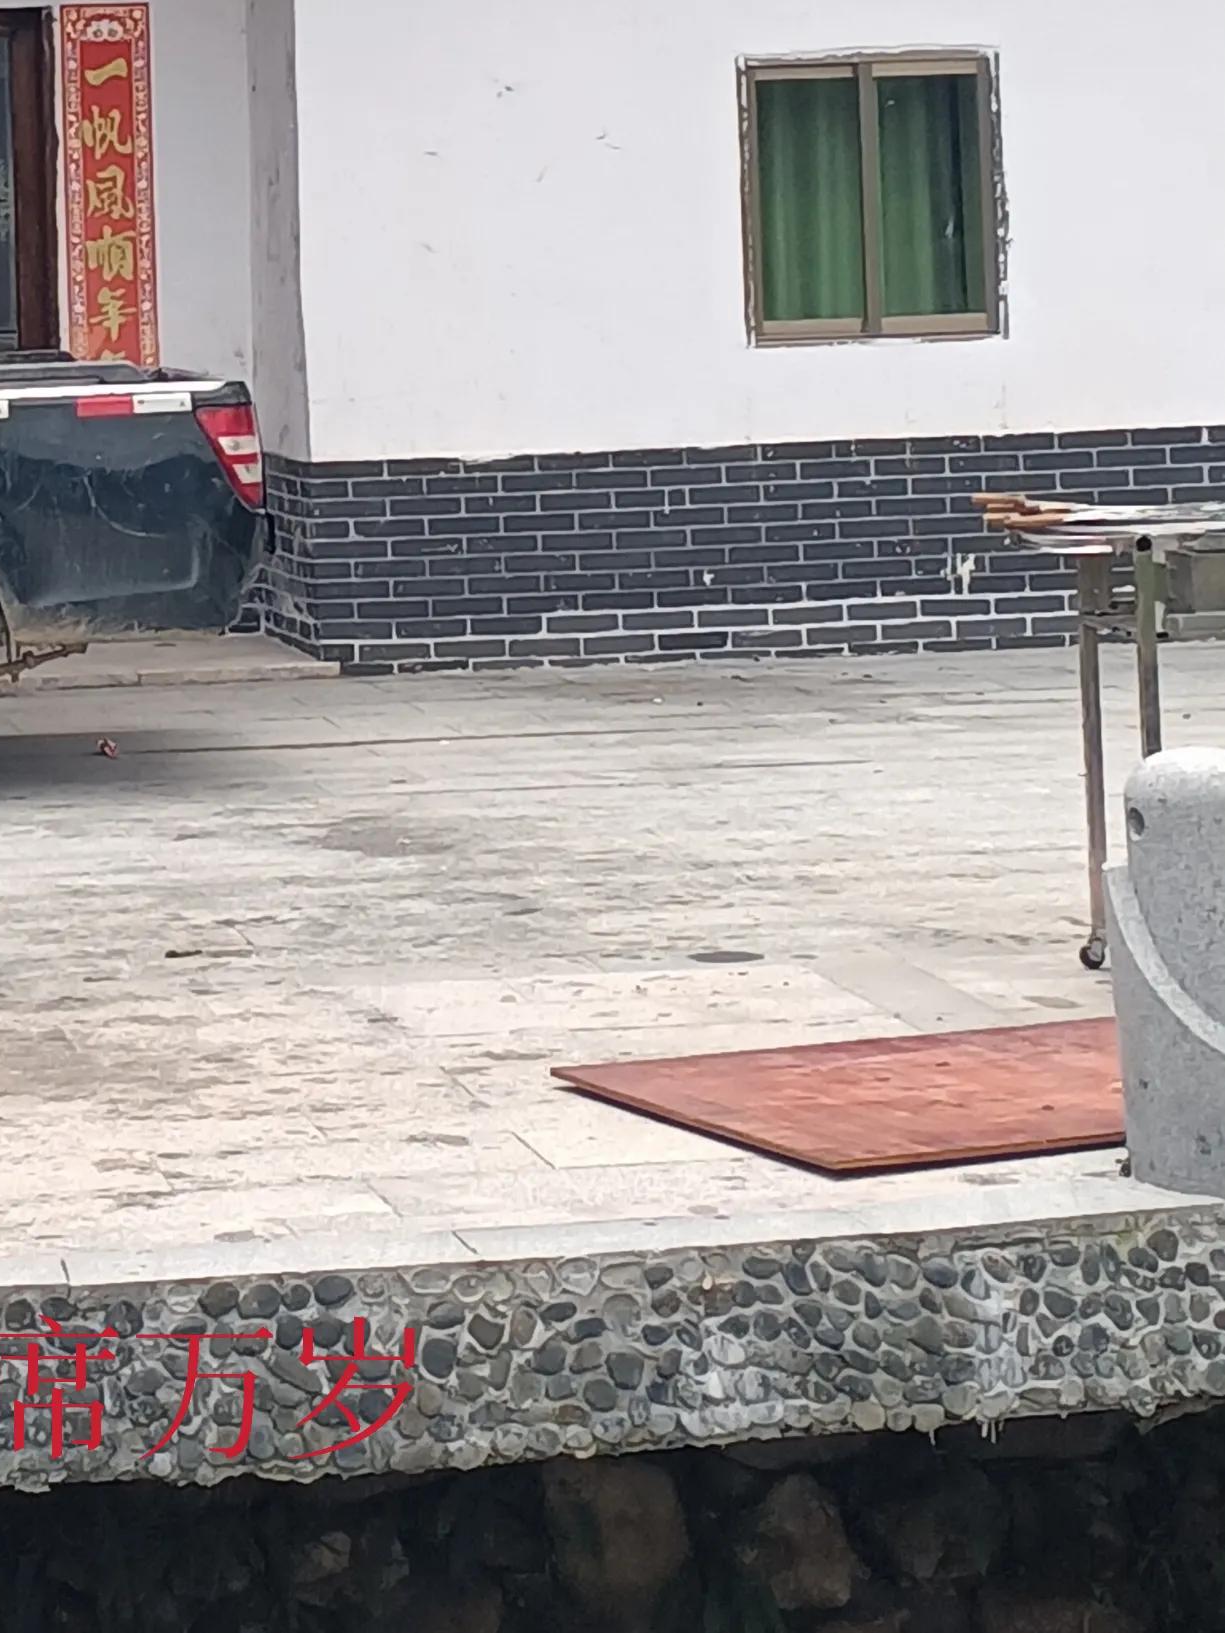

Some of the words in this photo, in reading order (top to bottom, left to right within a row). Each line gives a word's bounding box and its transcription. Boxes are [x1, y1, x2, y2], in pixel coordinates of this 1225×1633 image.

[80, 57, 138, 360] 一帆風順年
